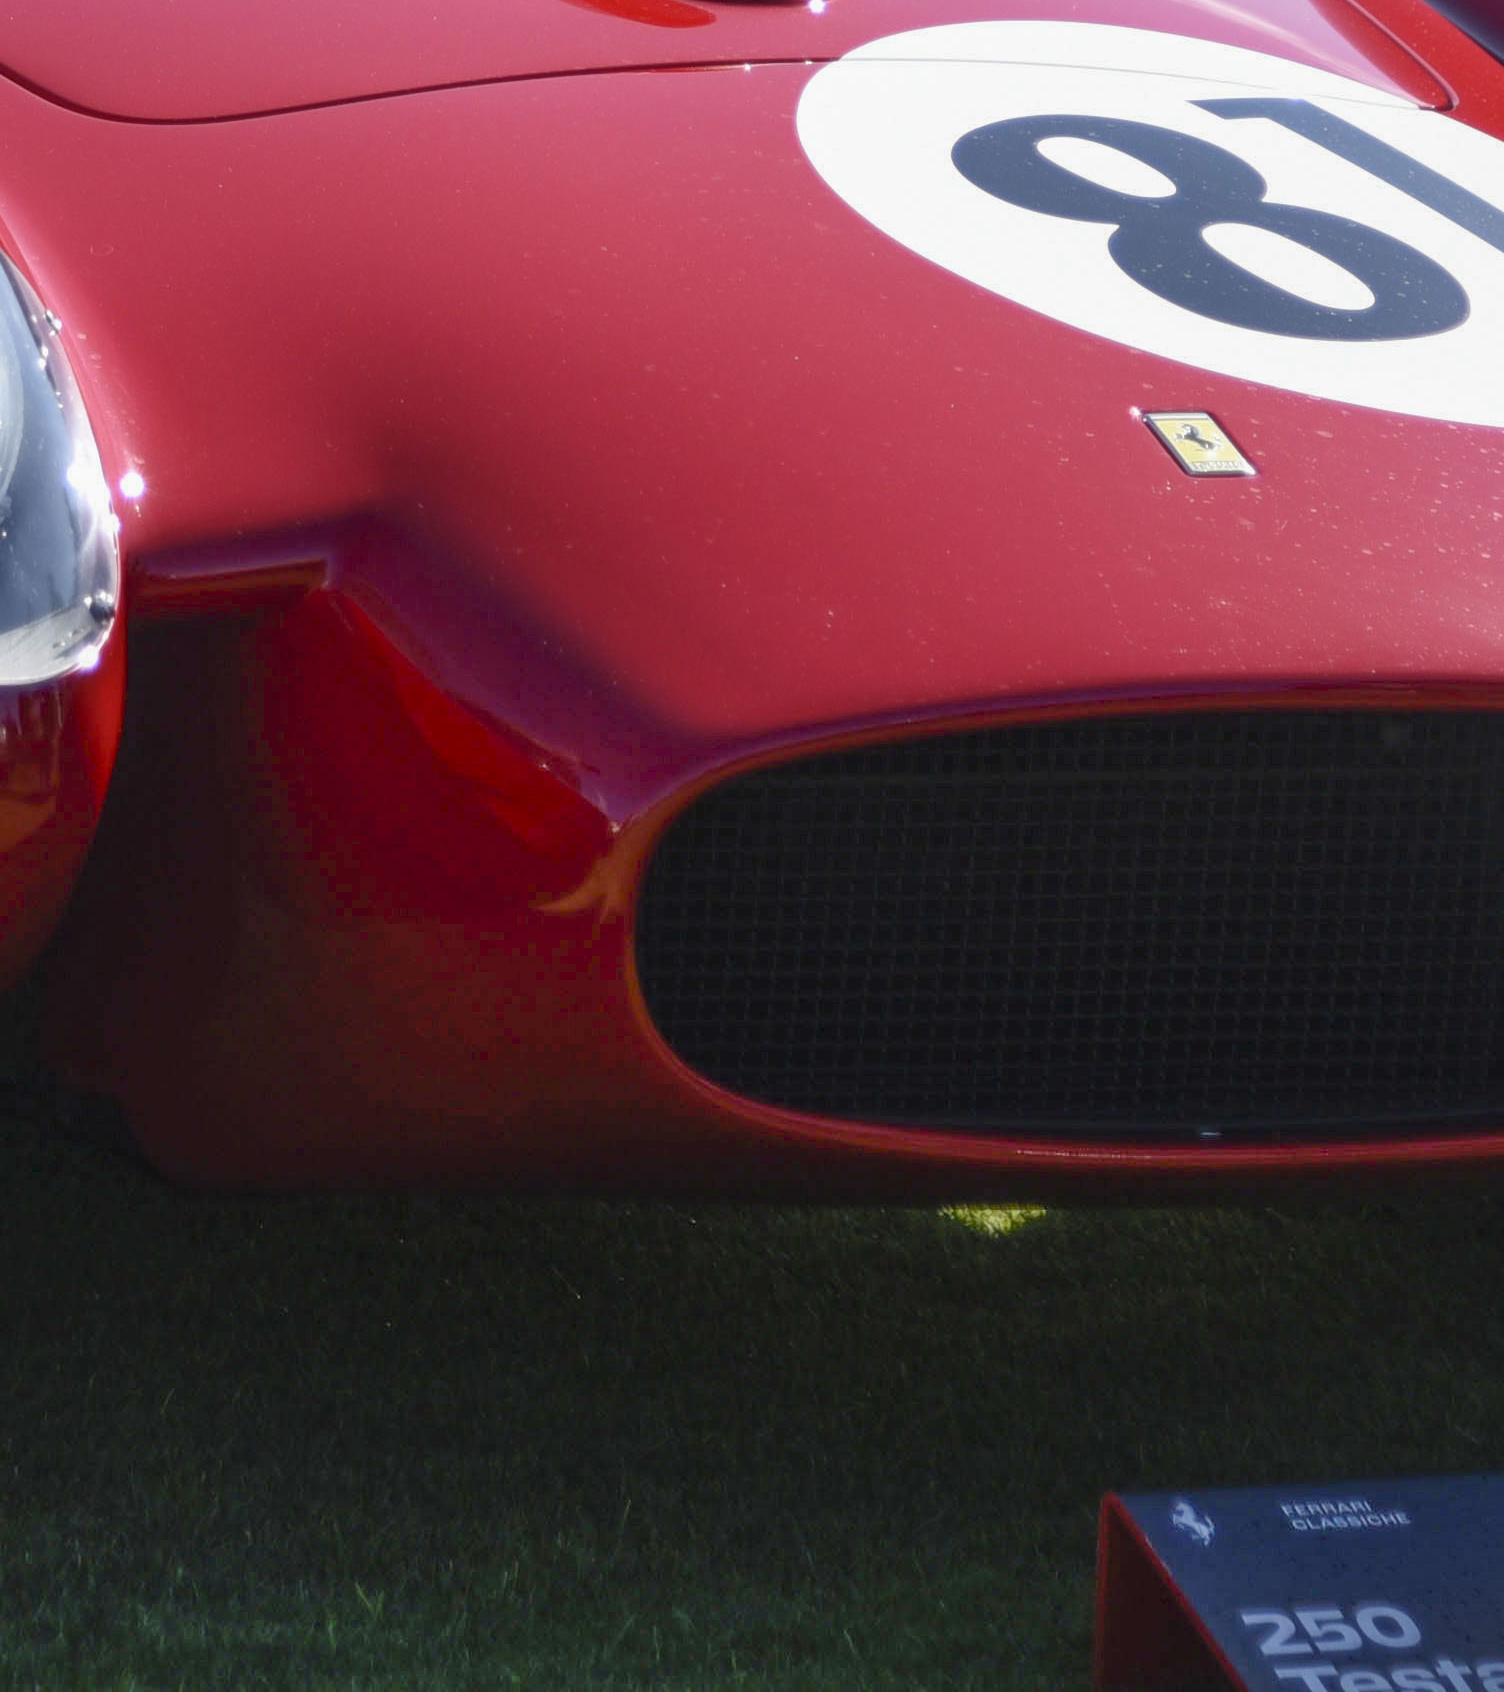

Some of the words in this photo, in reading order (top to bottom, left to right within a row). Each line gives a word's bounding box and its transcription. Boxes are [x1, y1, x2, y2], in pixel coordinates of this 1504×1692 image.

[1279, 1499, 1373, 1517] FERRARI
[1291, 1512, 1411, 1530] CLASSICHE
[1242, 1606, 1422, 1655] 250
